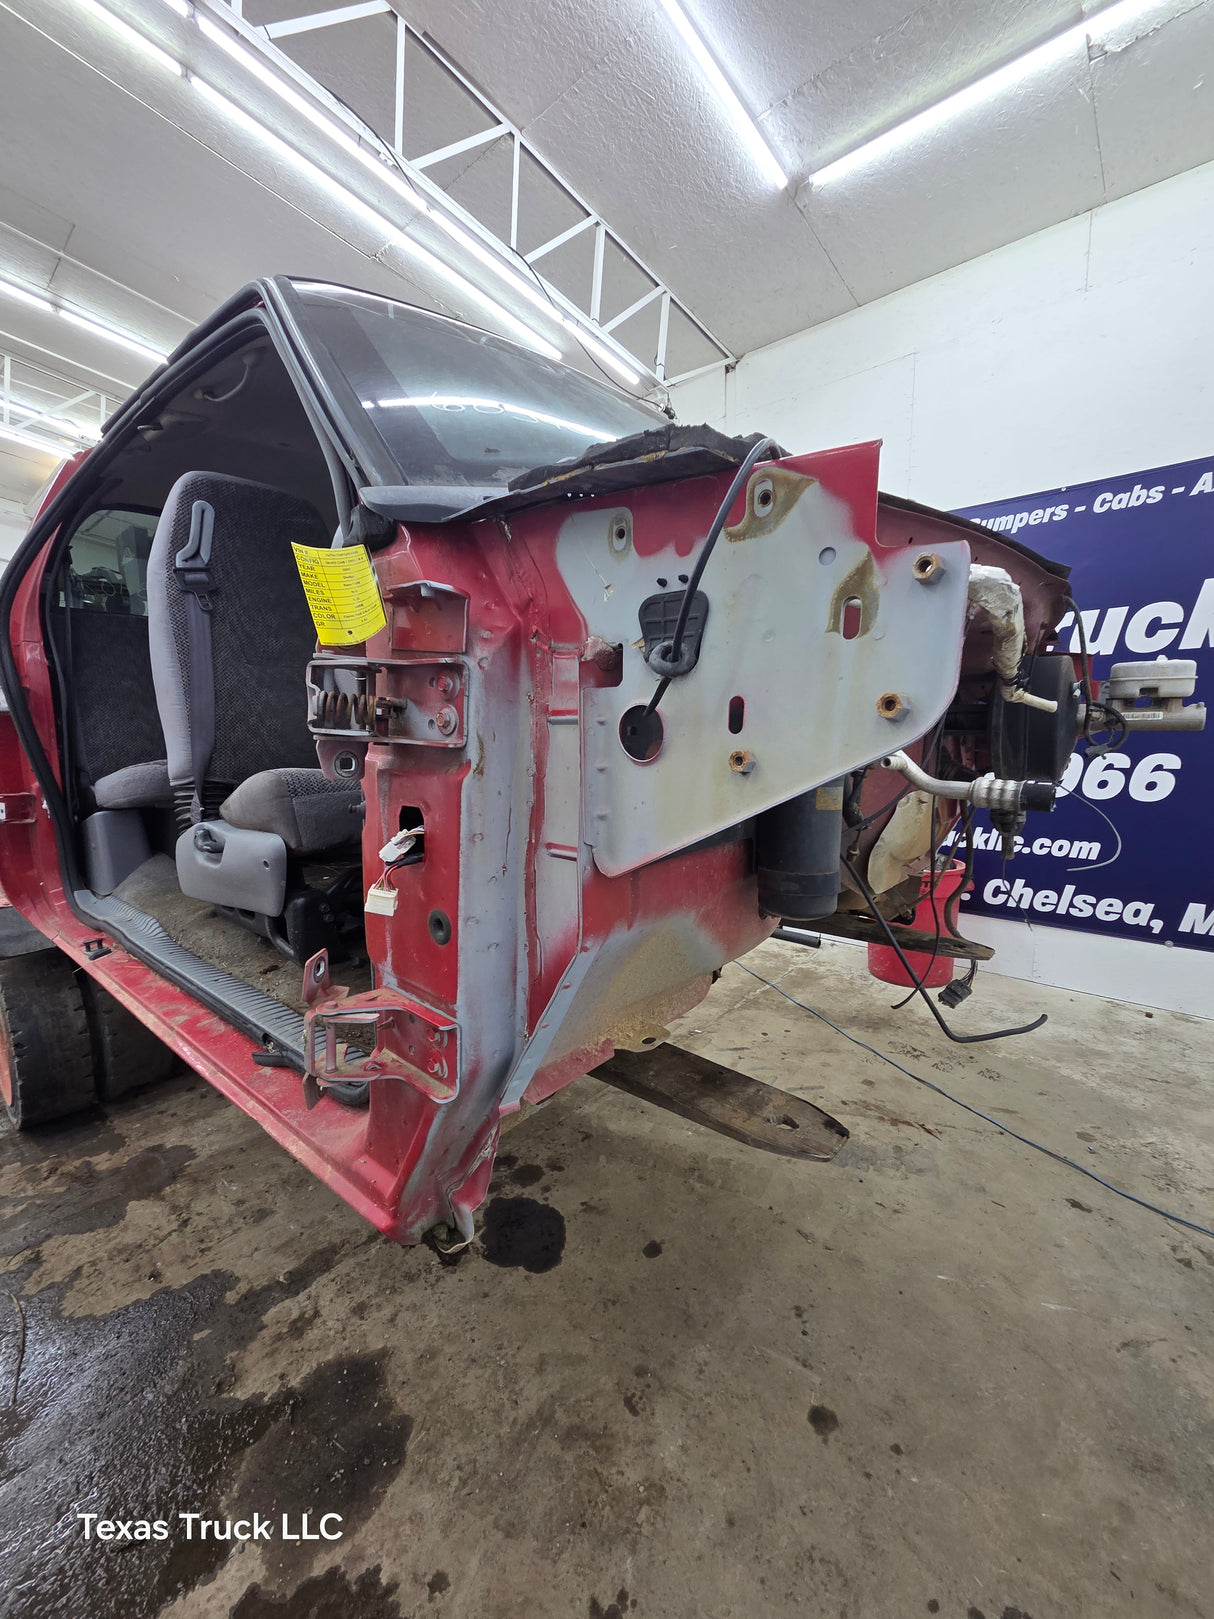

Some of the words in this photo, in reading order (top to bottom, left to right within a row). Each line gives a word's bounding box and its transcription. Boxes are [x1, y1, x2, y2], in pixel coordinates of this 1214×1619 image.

[1093, 484, 1165, 514] Cabs
[1188, 471, 1214, 496] A
[299, 564, 316, 572] YEAR
[301, 572, 319, 580] MAKE
[303, 579, 326, 588] MODEL
[306, 588, 325, 596] MILES
[308, 596, 333, 604] ENGINE
[311, 604, 333, 612] TRANS
[313, 612, 337, 620] COLOR
[982, 877, 1164, 934] Chelsea,
